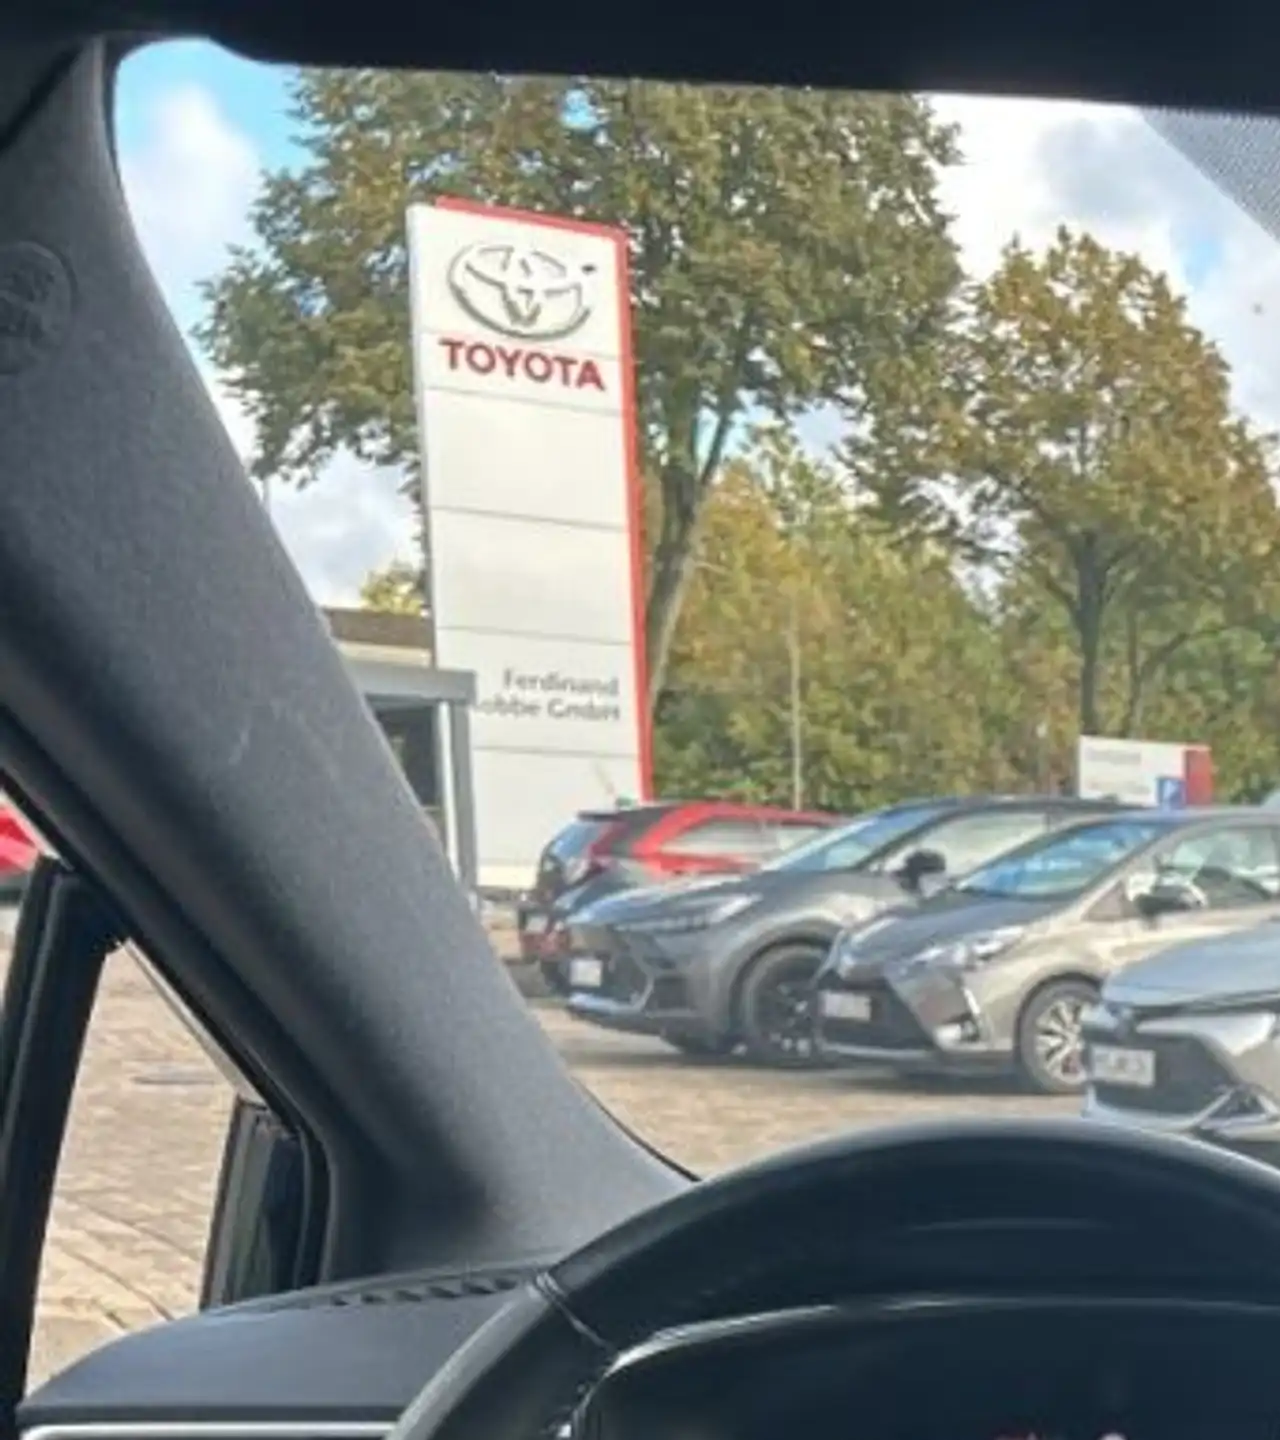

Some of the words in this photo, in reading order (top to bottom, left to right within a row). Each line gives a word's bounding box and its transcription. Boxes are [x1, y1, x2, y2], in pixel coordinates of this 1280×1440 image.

[437, 337, 607, 392] TOYOTA
[503, 669, 620, 697] Ferdinand
[472, 693, 541, 717] obbe
[547, 698, 620, 721] GmbH
